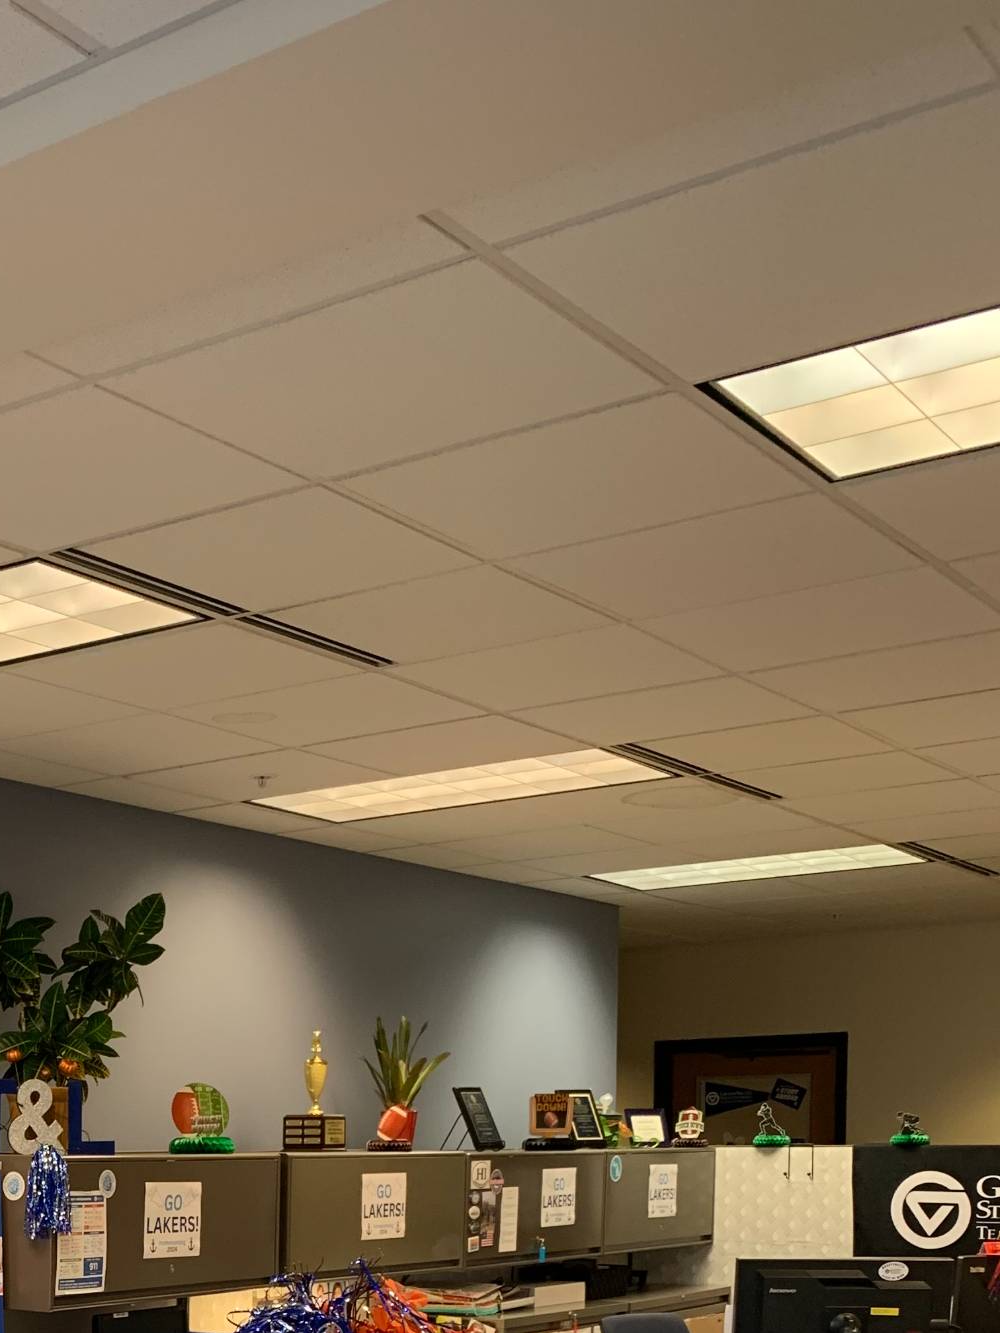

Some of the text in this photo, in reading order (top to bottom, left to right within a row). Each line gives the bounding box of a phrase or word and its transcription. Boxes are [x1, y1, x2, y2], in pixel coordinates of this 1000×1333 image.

[377, 1184, 392, 1199] GO
[554, 1177, 566, 1191] GO
[164, 1194, 183, 1211] GO
[542, 1194, 576, 1209] LAKERS!
[363, 1203, 404, 1219] LAKERS!
[146, 1215, 199, 1234] LAKERS!
